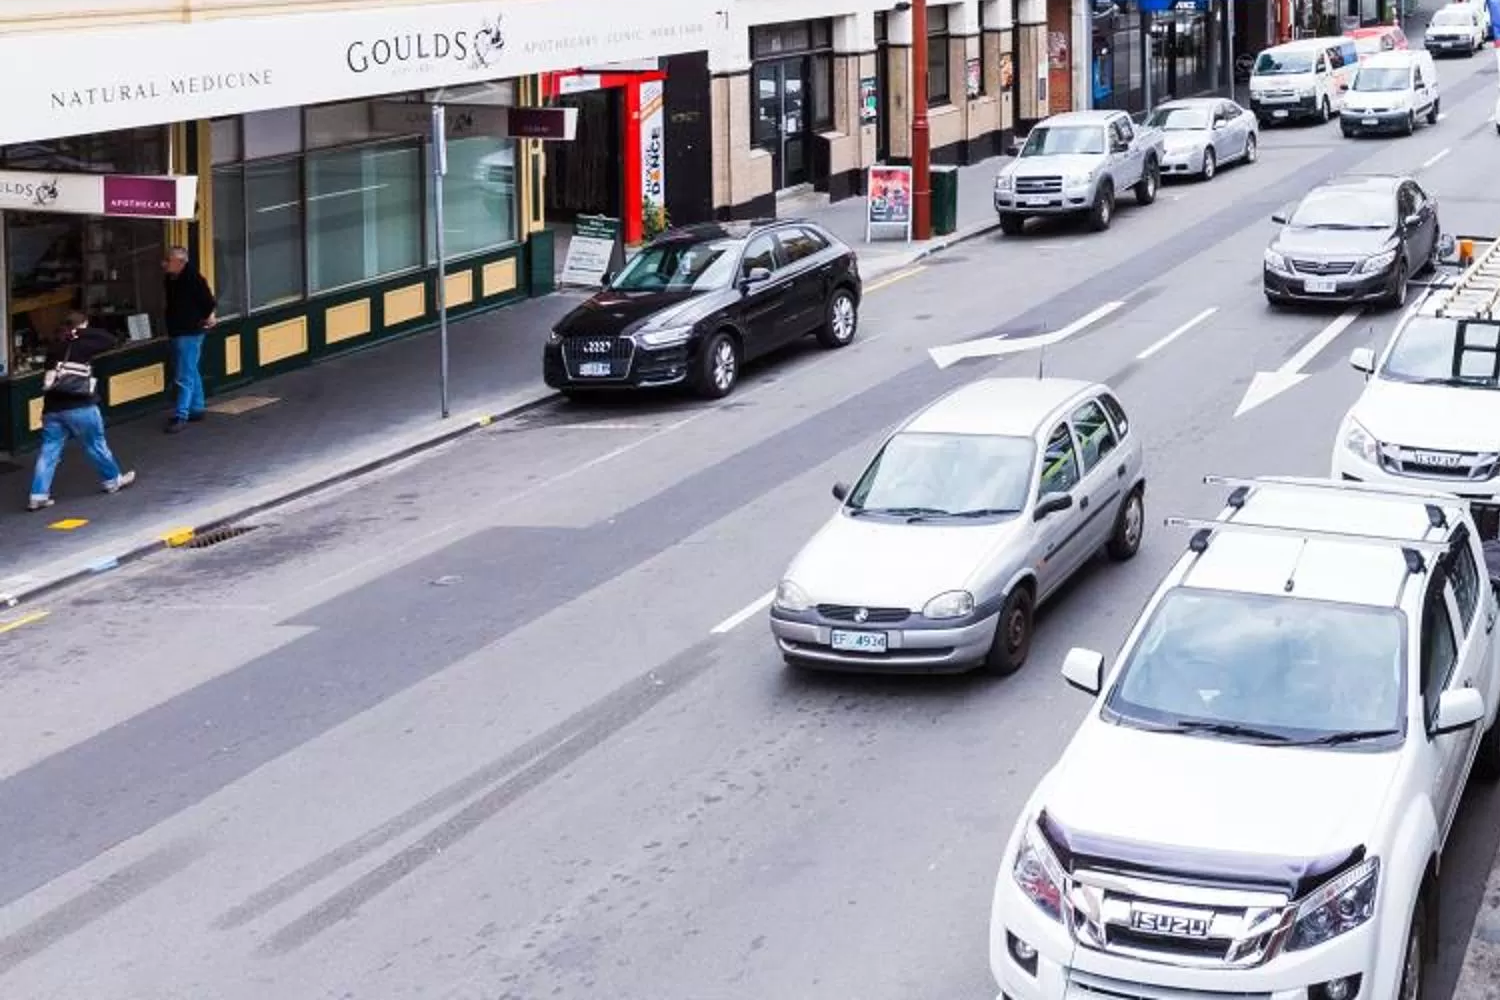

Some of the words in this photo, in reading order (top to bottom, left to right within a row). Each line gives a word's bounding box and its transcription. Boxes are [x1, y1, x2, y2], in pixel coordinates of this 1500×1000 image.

[346, 30, 468, 73] GOULDS
[50, 82, 161, 110] NATURAL
[170, 68, 274, 97] MEDICINE
[0, 182, 33, 198] LDS
[1133, 910, 1207, 937] ISUZU
